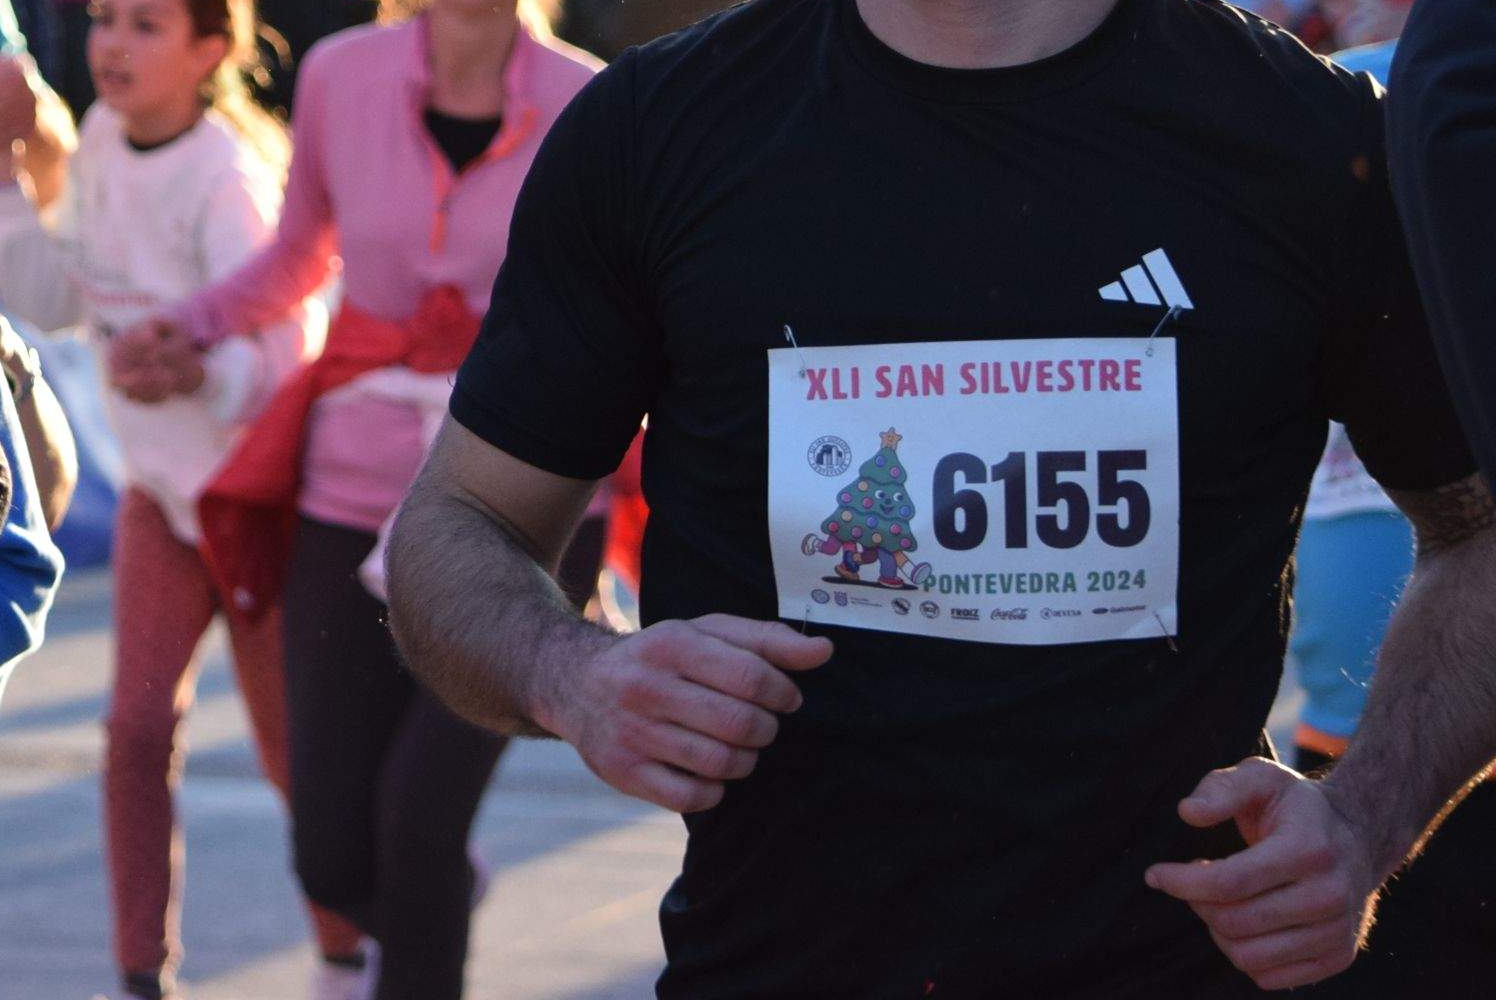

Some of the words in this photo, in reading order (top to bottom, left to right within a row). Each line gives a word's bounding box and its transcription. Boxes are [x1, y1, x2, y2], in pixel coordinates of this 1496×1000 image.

[806, 366, 860, 400] XLI
[874, 363, 944, 397] SAN
[959, 359, 1143, 395] SILVESTRE
[932, 449, 1152, 552] 6155
[923, 572, 1077, 595] PONTEVEDRA
[1087, 569, 1147, 592] 2024
